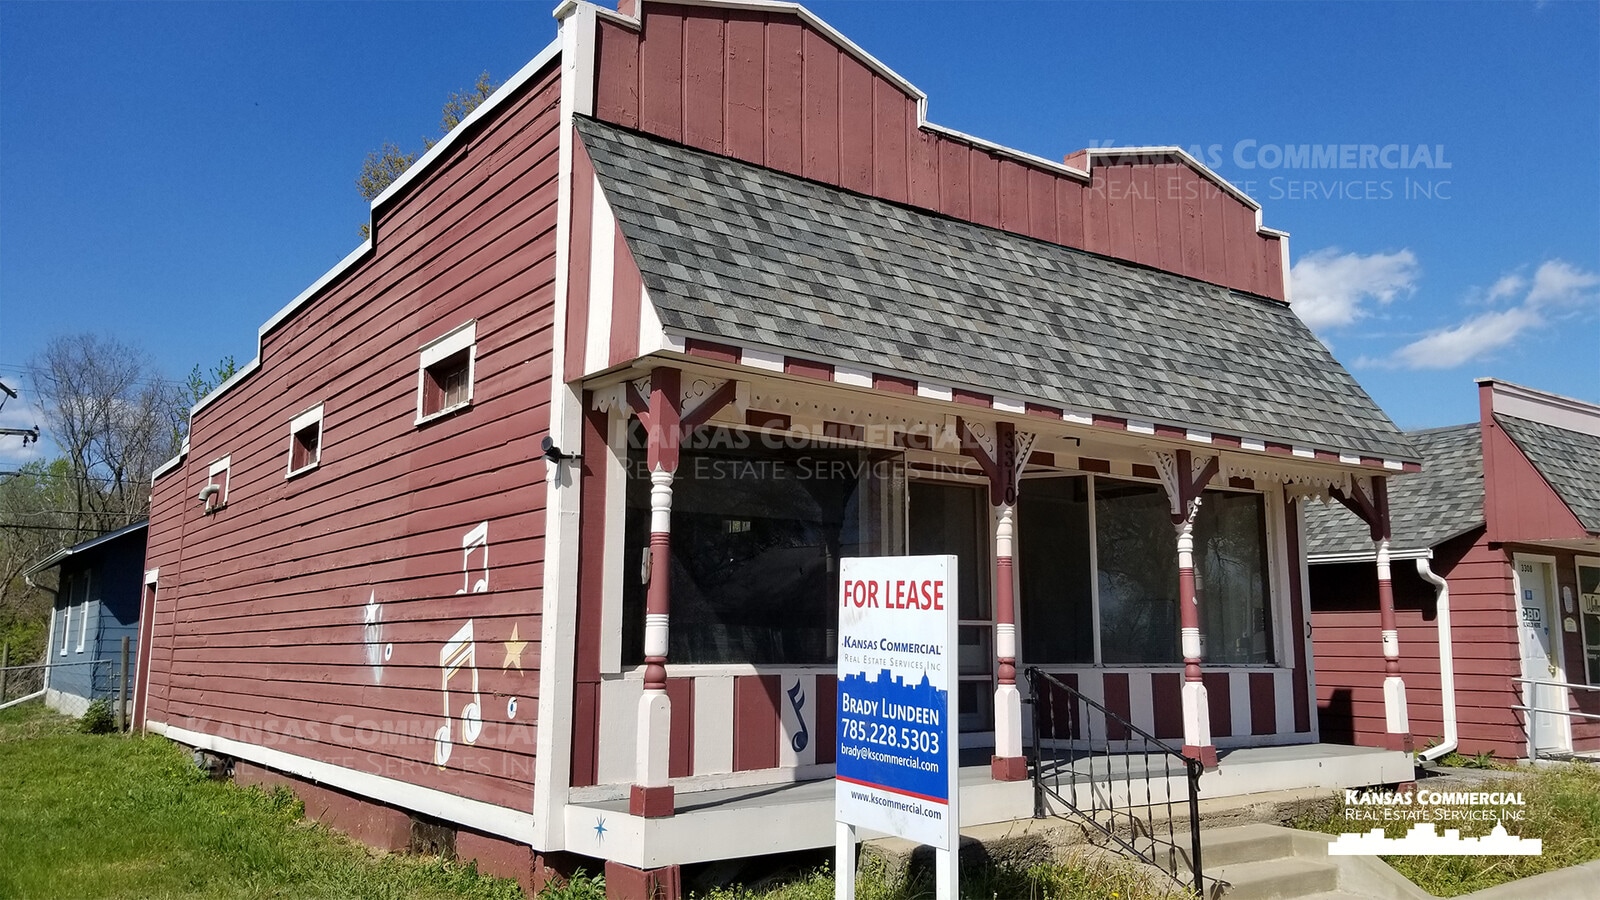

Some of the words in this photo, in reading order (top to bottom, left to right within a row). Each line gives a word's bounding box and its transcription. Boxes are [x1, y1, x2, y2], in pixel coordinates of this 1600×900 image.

[1004, 430, 1015, 503] 3310
[844, 580, 879, 608] FOR
[885, 580, 944, 610] LEASE
[1522, 607, 1540, 621] CBD
[844, 635, 878, 650] KANSAS
[879, 638, 941, 655] COMMERCIAL
[844, 653, 860, 663] REAL
[863, 655, 887, 666] ESTATE
[889, 657, 923, 669] SERVICES
[926, 660, 941, 671] INC
[842, 692, 879, 716] BRADY
[882, 698, 939, 726] LUNDEEN
[841, 718, 940, 754] 785.228.5303
[841, 743, 939, 773] brady@kscommercial.com
[851, 790, 942, 820] www.kscommercial.com
